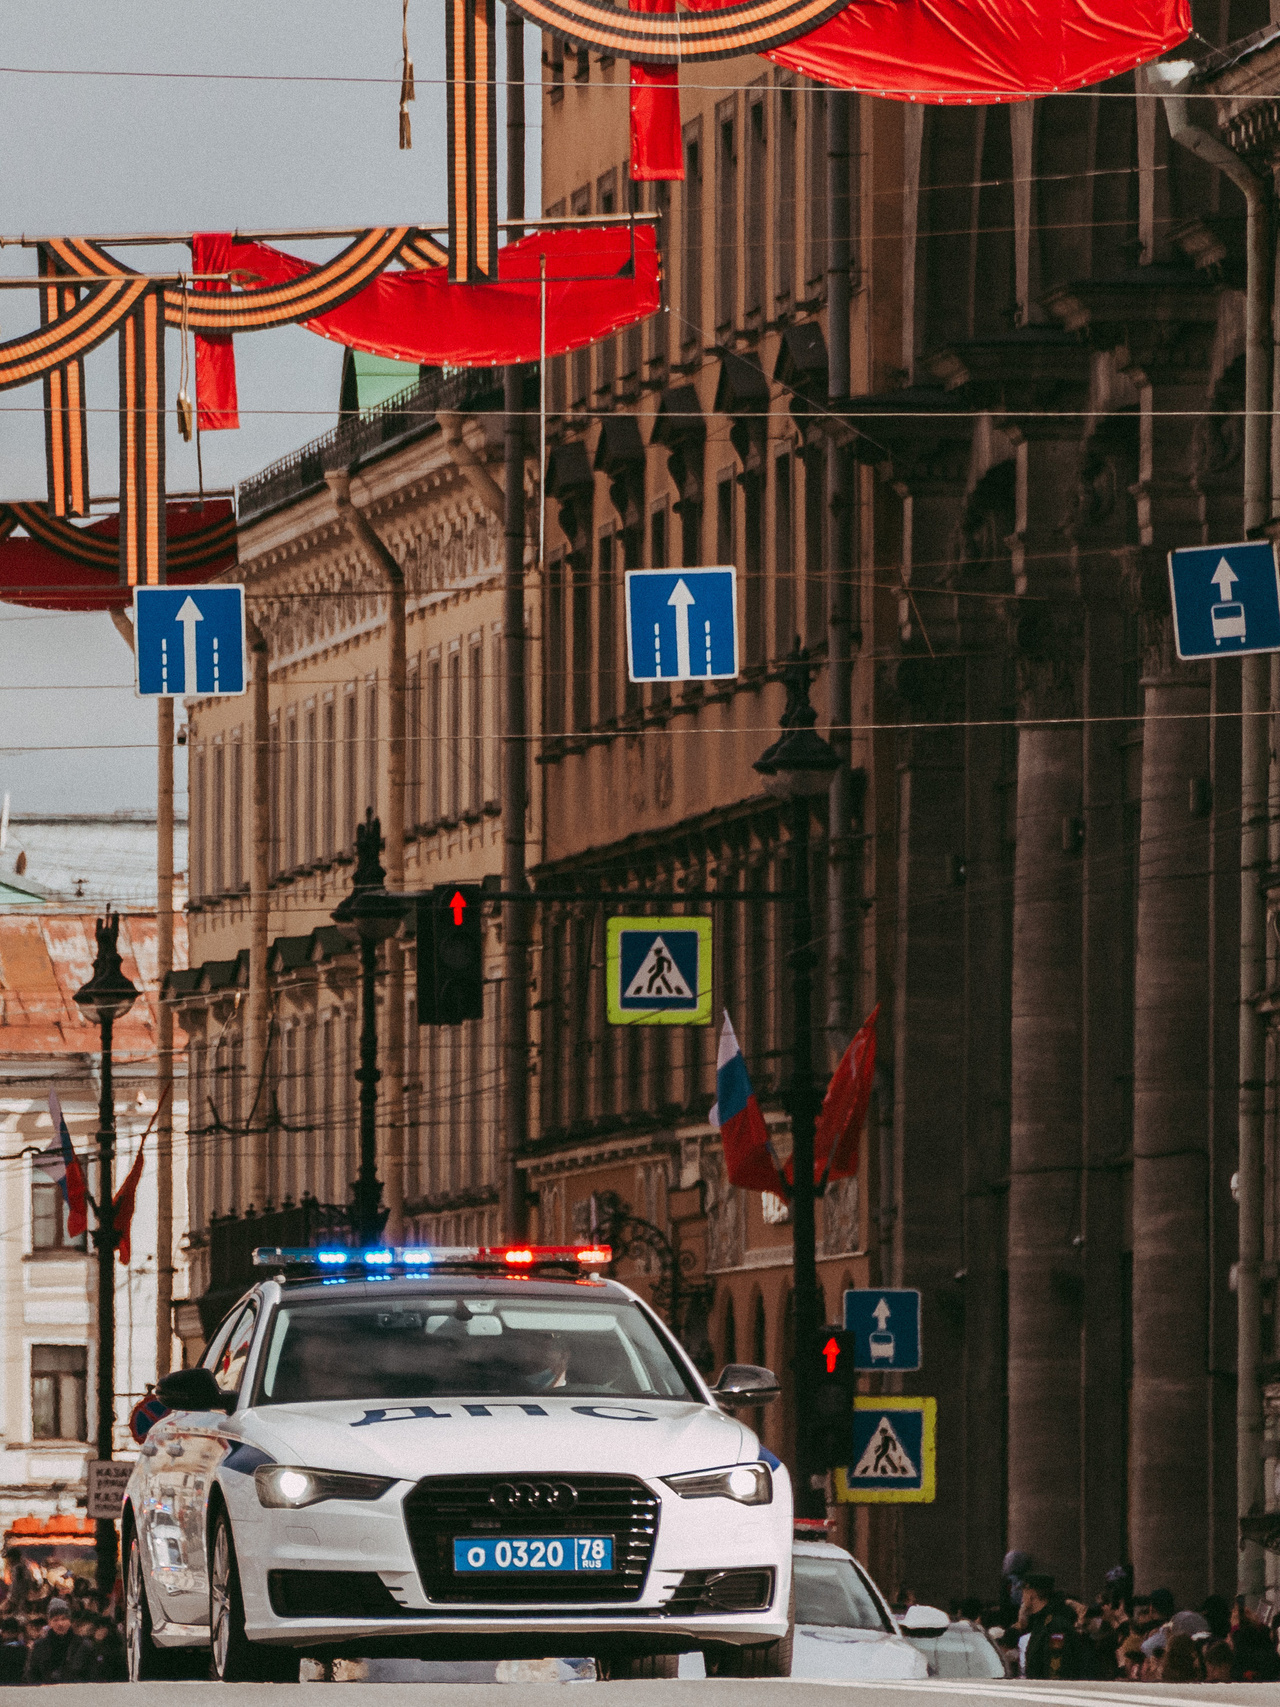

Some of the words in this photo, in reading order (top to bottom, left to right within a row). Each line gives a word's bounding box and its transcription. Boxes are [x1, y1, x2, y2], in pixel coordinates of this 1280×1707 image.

[349, 1403, 658, 1427] ДПС
[495, 1541, 564, 1568] 0320
[578, 1539, 606, 1560] 78
[582, 1560, 602, 1568] RUS
